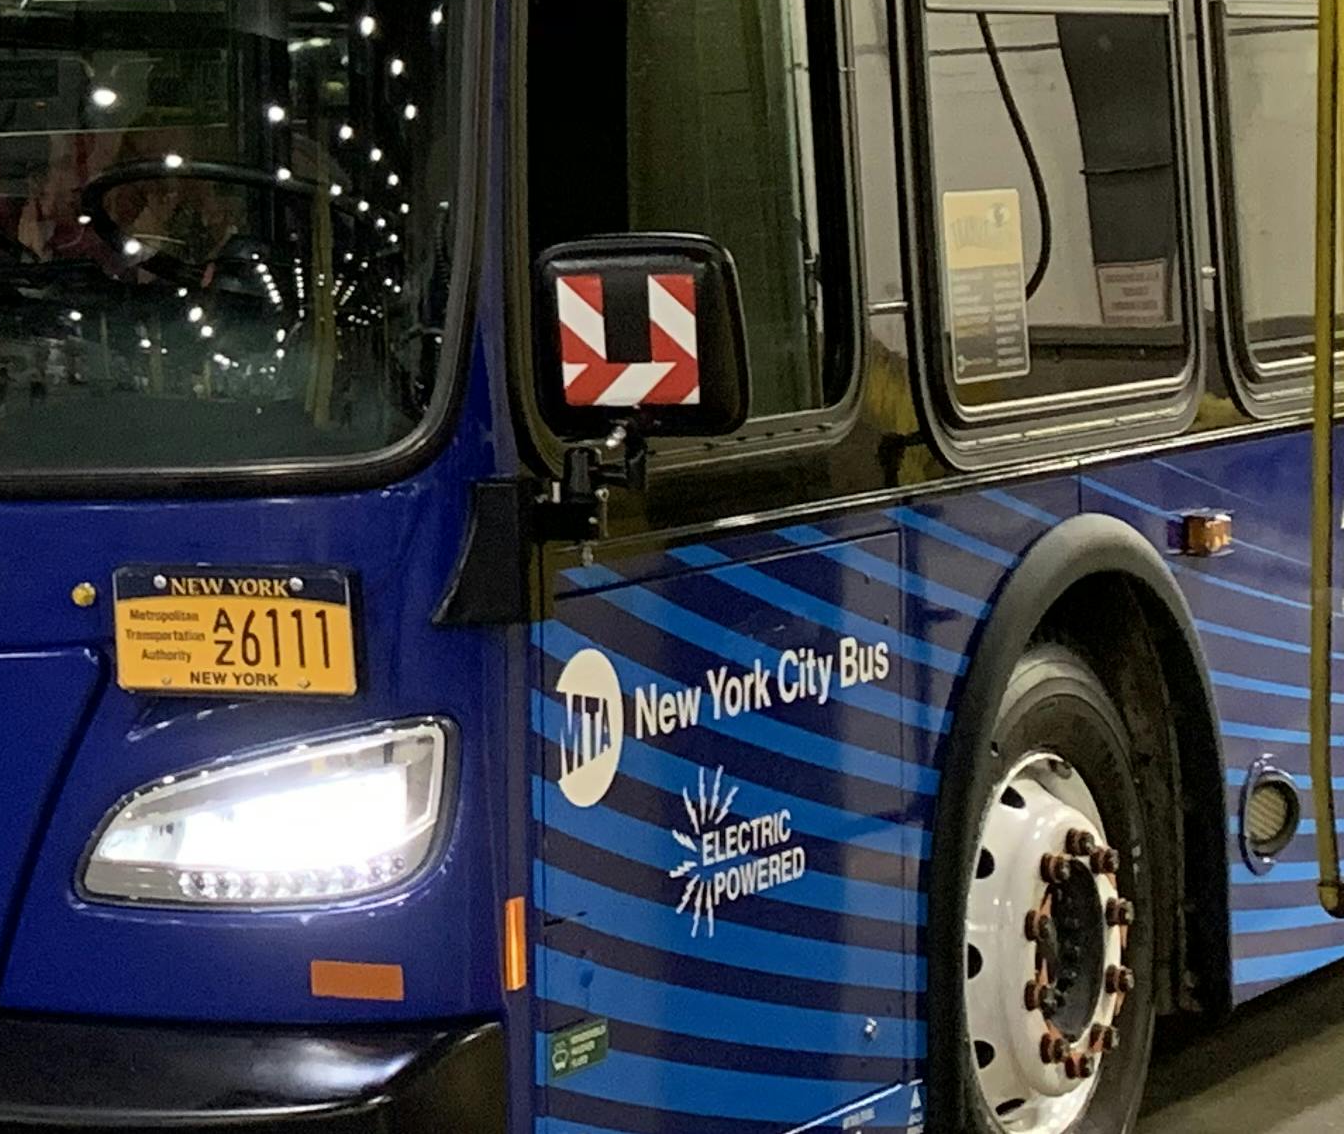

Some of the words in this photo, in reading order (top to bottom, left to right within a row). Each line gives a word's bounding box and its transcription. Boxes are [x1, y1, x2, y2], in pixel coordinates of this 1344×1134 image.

[171, 577, 225, 596] NEW
[227, 577, 290, 598] YORK
[128, 608, 200, 624] Metropolitan
[125, 628, 206, 643] Transportation
[141, 647, 192, 664] Authority
[190, 671, 226, 686] NEW
[232, 672, 279, 687] YORK
[635, 683, 702, 739] New
[707, 658, 771, 720] York
[777, 647, 833, 704] City
[839, 636, 890, 688] Bus
[702, 809, 791, 866] ELECTRIC
[714, 846, 806, 906] POWERED
